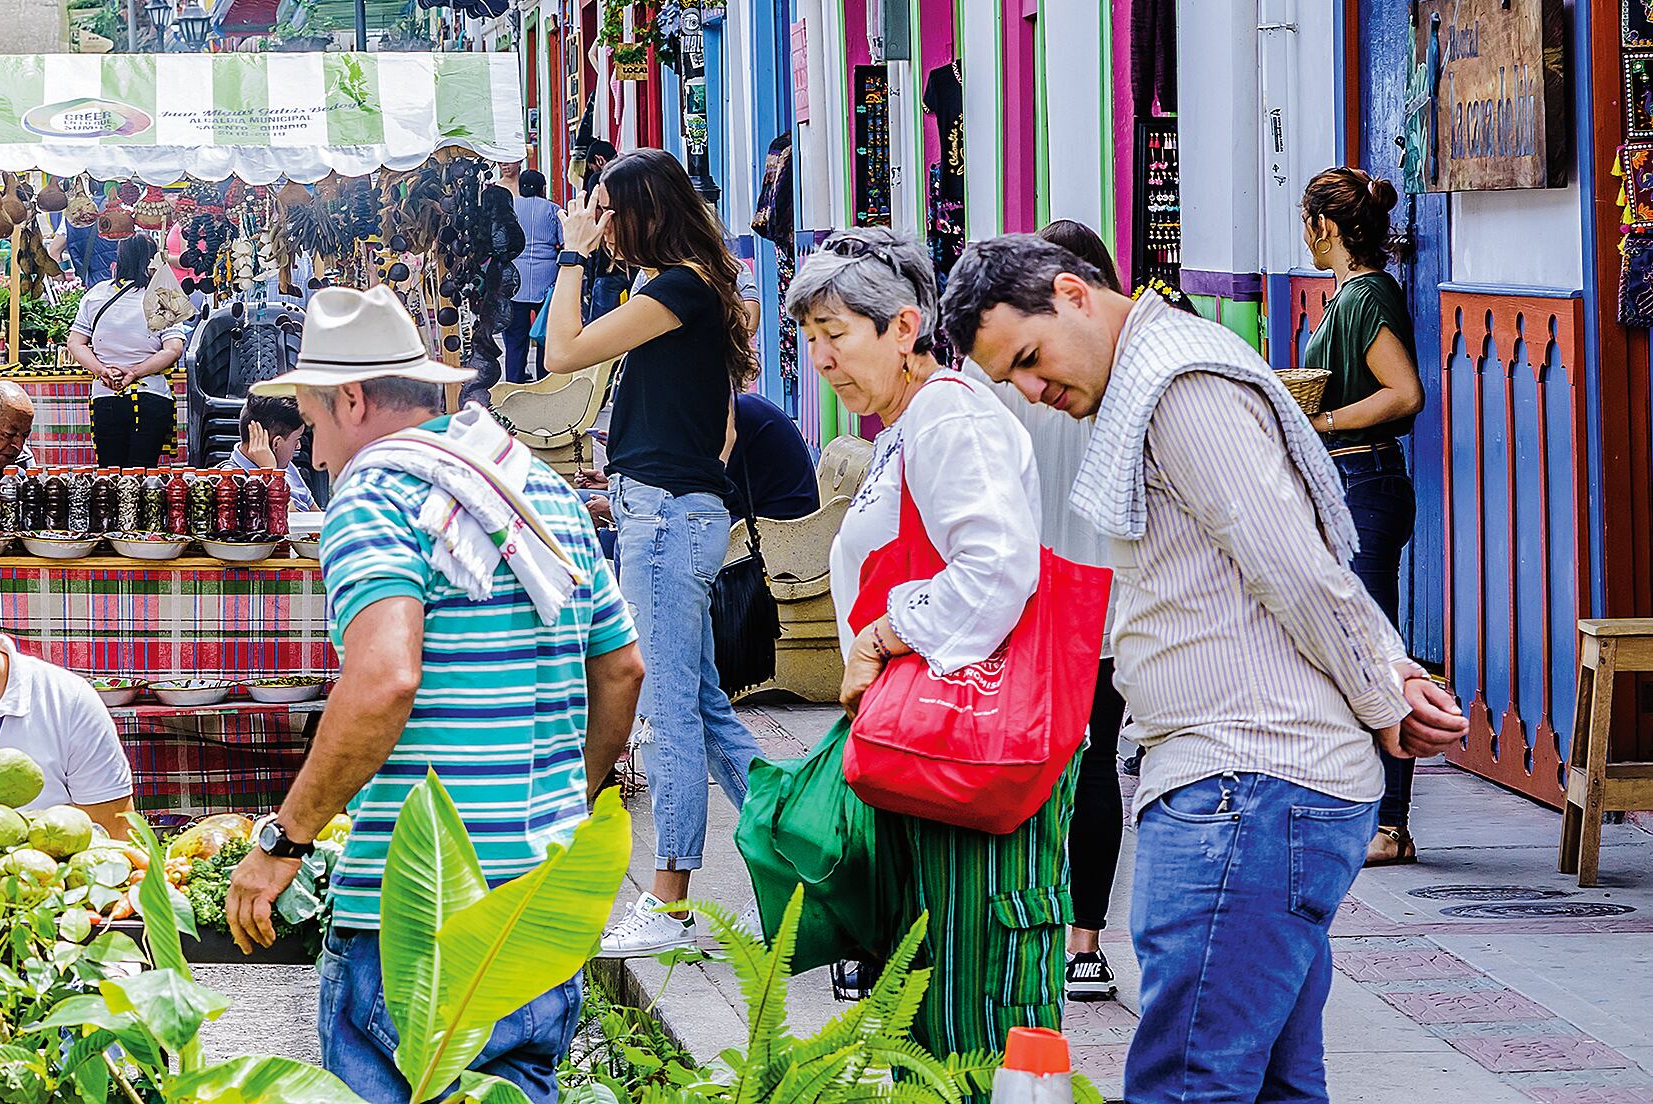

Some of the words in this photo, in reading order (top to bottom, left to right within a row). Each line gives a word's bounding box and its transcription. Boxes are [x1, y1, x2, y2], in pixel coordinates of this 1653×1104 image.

[309, 102, 361, 114] Bedoy
[64, 111, 113, 122] CREER
[250, 115, 312, 124] MUNICIPAL
[963, 667, 999, 690] ROMIS
[1072, 962, 1102, 978] NIKE
